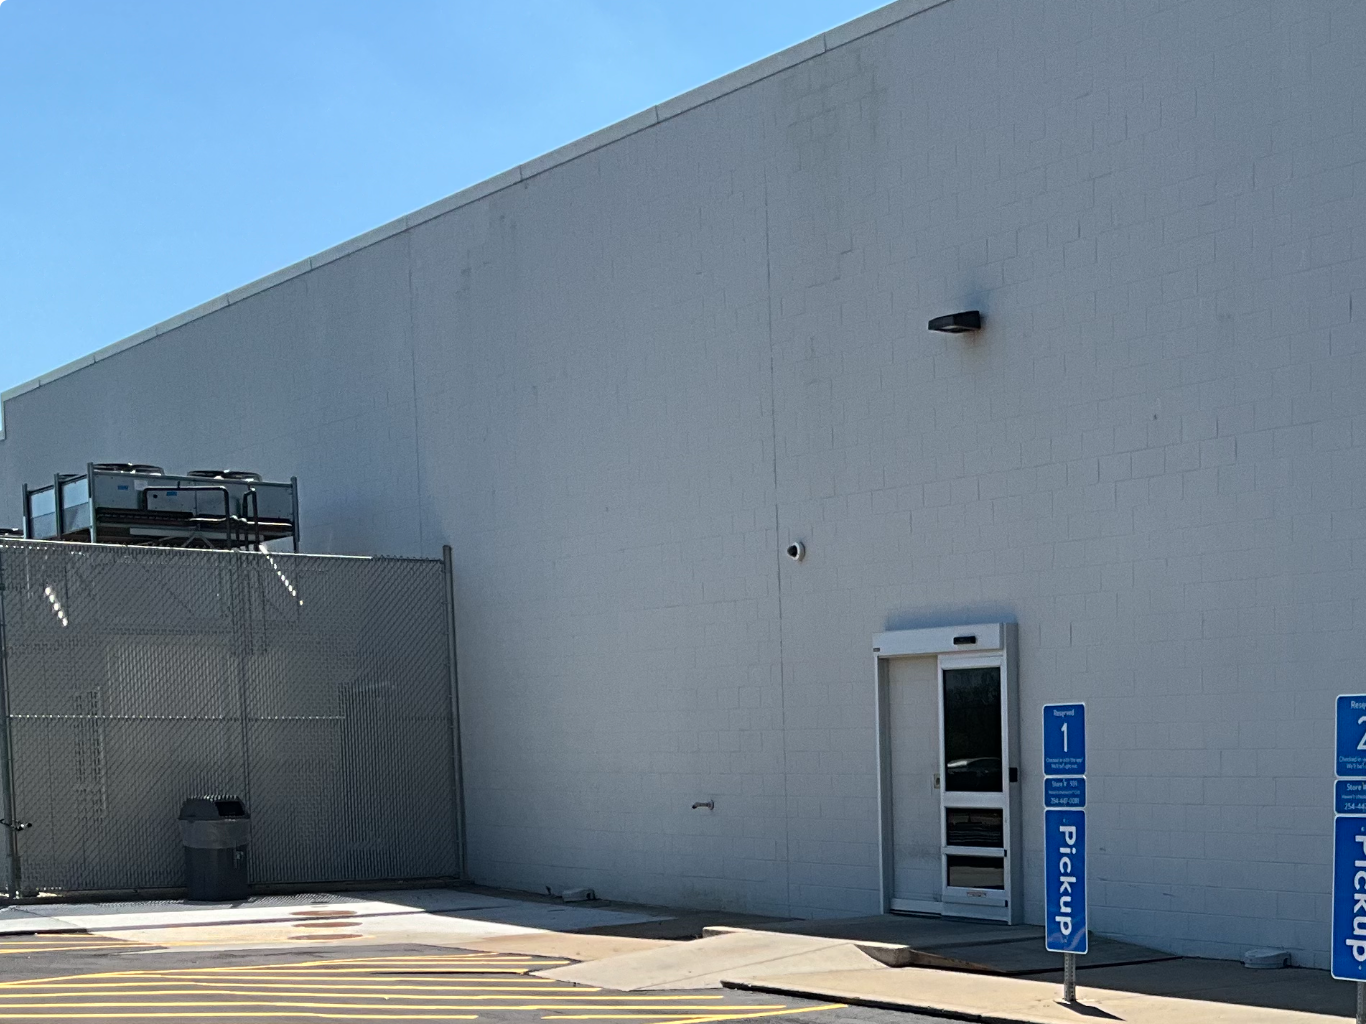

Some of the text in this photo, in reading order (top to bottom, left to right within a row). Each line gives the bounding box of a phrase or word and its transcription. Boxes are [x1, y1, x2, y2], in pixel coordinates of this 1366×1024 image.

[1061, 722, 1068, 752] 1
[1347, 783, 1361, 791] Store
[1055, 825, 1077, 936] Pickup
